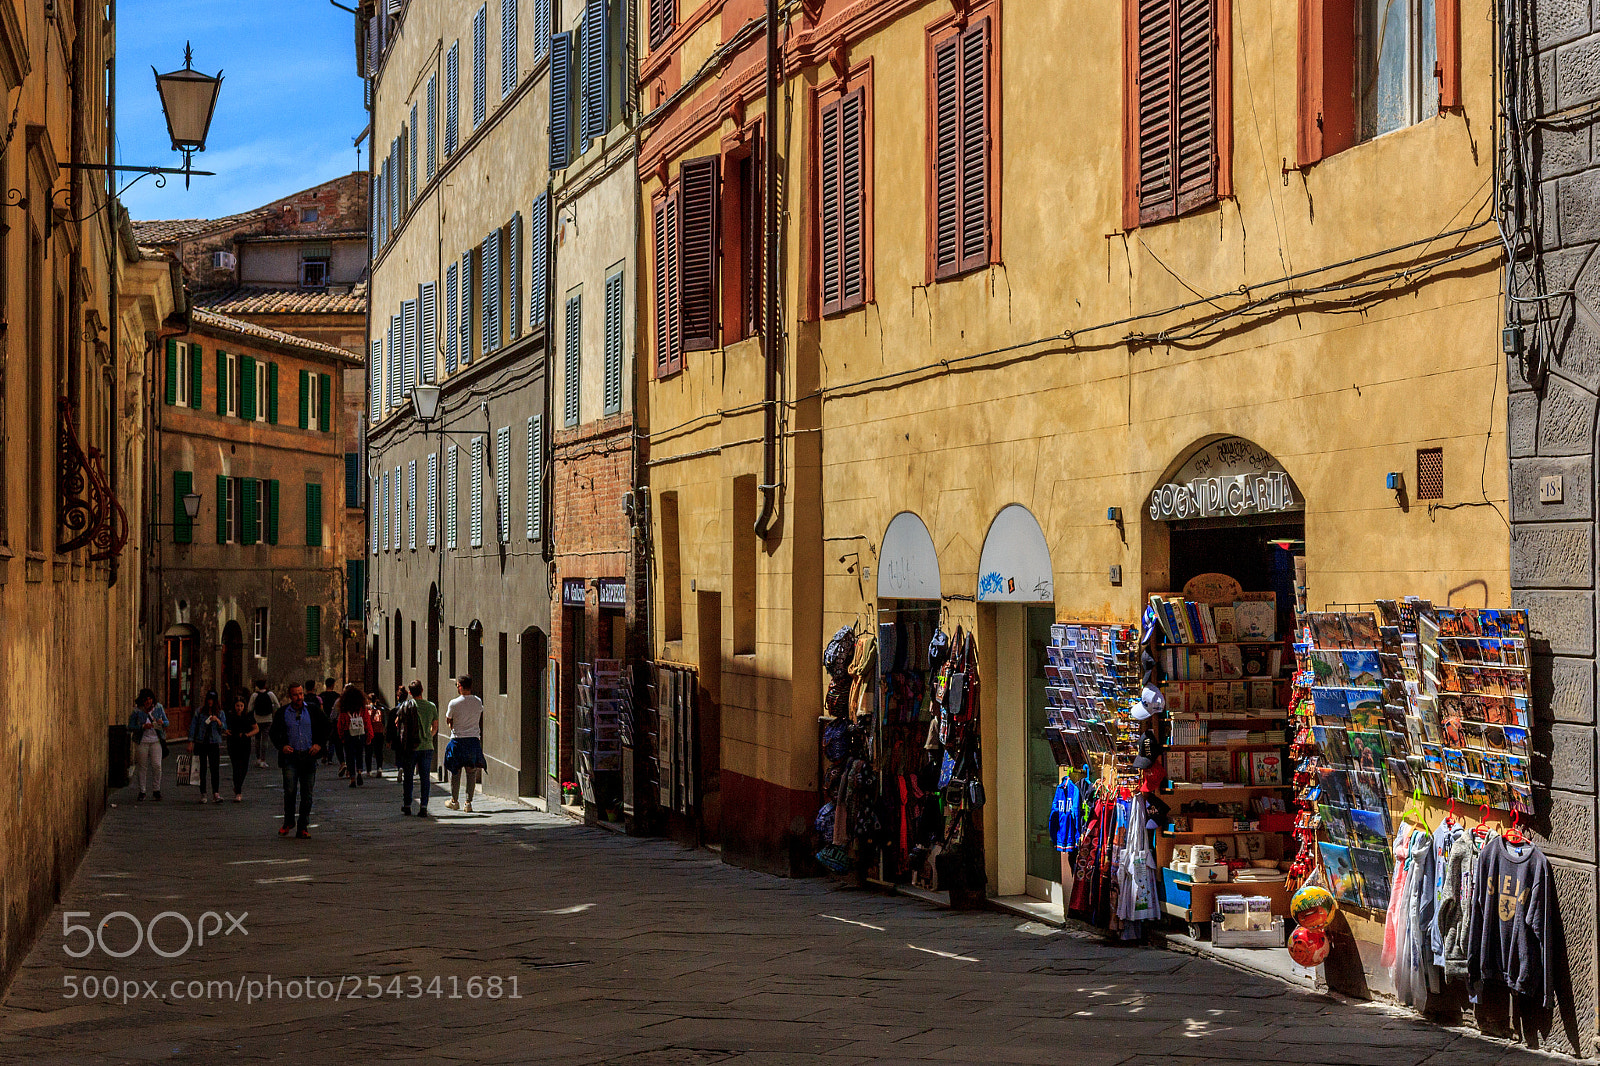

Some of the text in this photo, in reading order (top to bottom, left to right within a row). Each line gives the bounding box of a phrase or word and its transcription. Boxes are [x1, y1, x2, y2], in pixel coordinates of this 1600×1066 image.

[1226, 471, 1294, 517] CARTA
[1546, 480, 1556, 497] 18
[1347, 691, 1378, 701] TOSCANA
